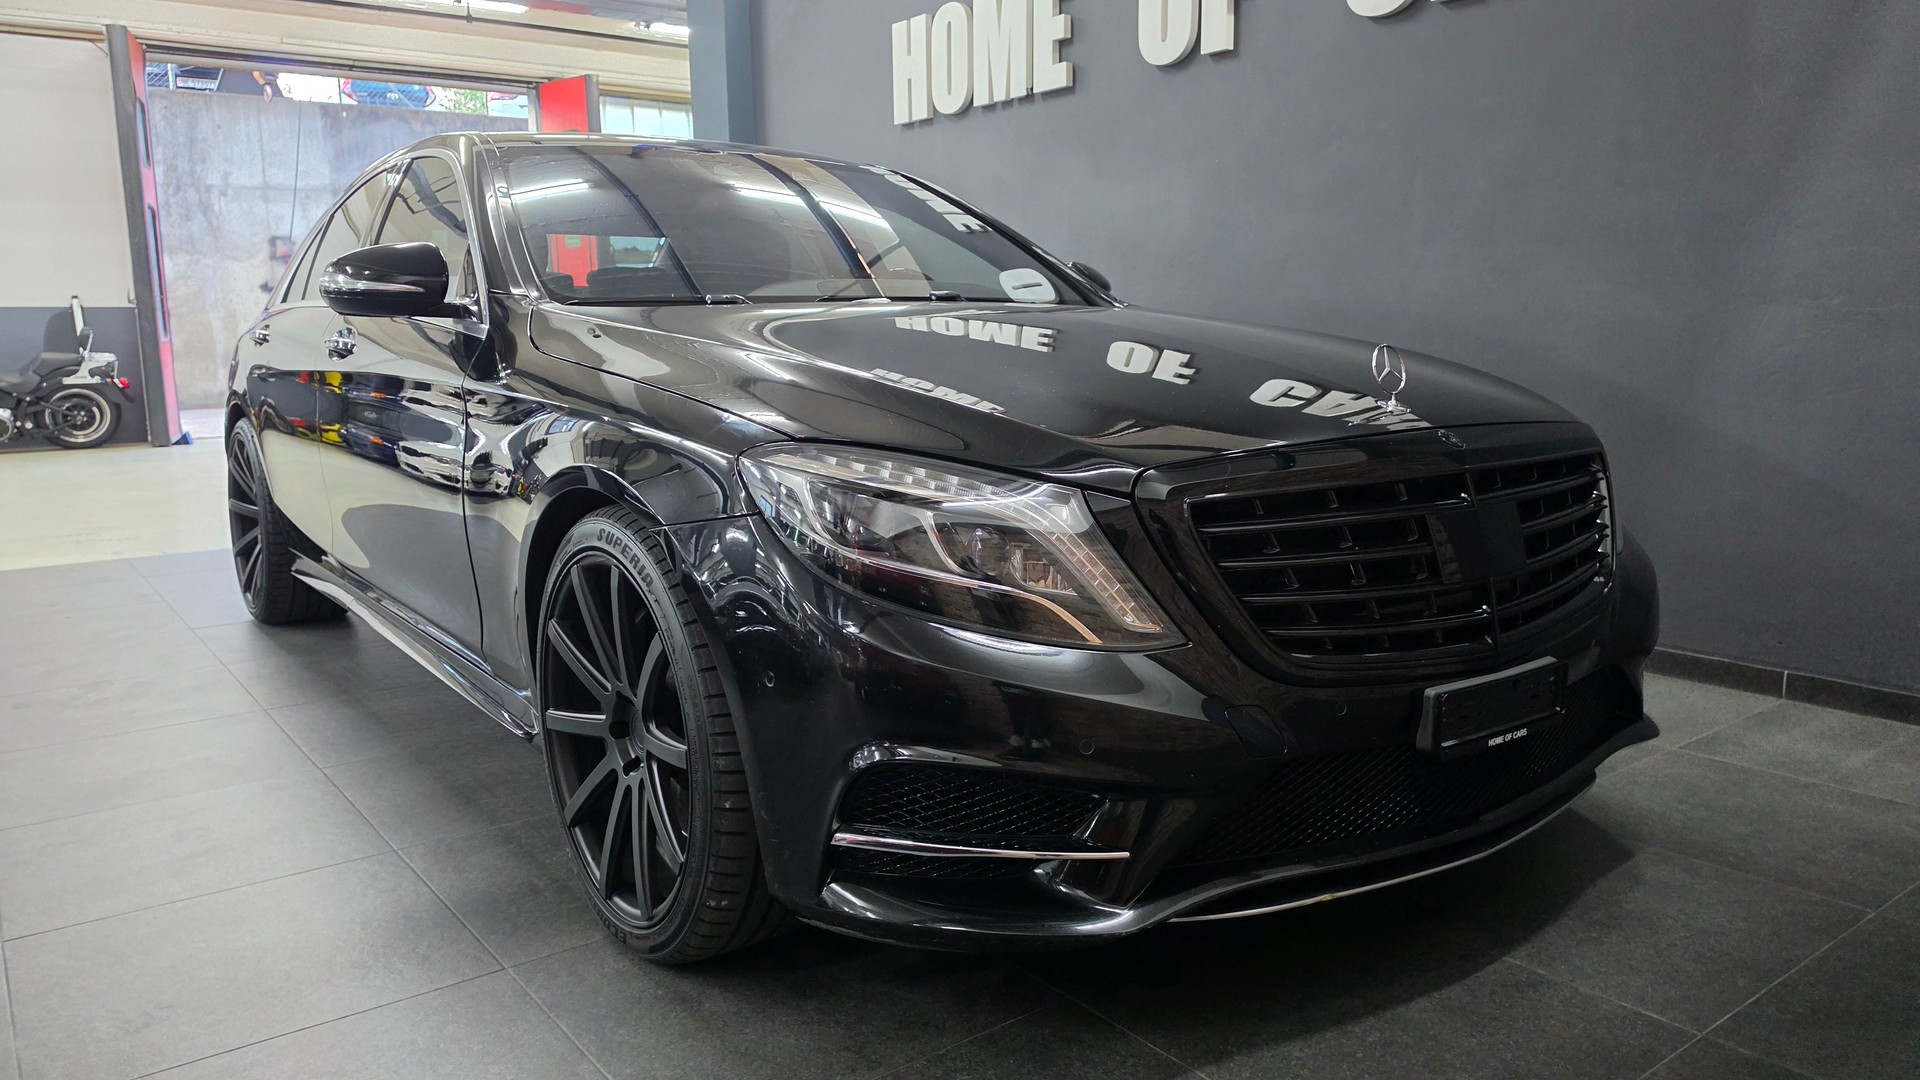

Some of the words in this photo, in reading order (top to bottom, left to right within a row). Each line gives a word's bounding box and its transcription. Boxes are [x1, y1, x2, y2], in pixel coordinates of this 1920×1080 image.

[892, 0, 1073, 125] HOME
[1488, 735, 1504, 747] HOME
[1504, 732, 1513, 742] OF
[1513, 728, 1528, 739] CARS
